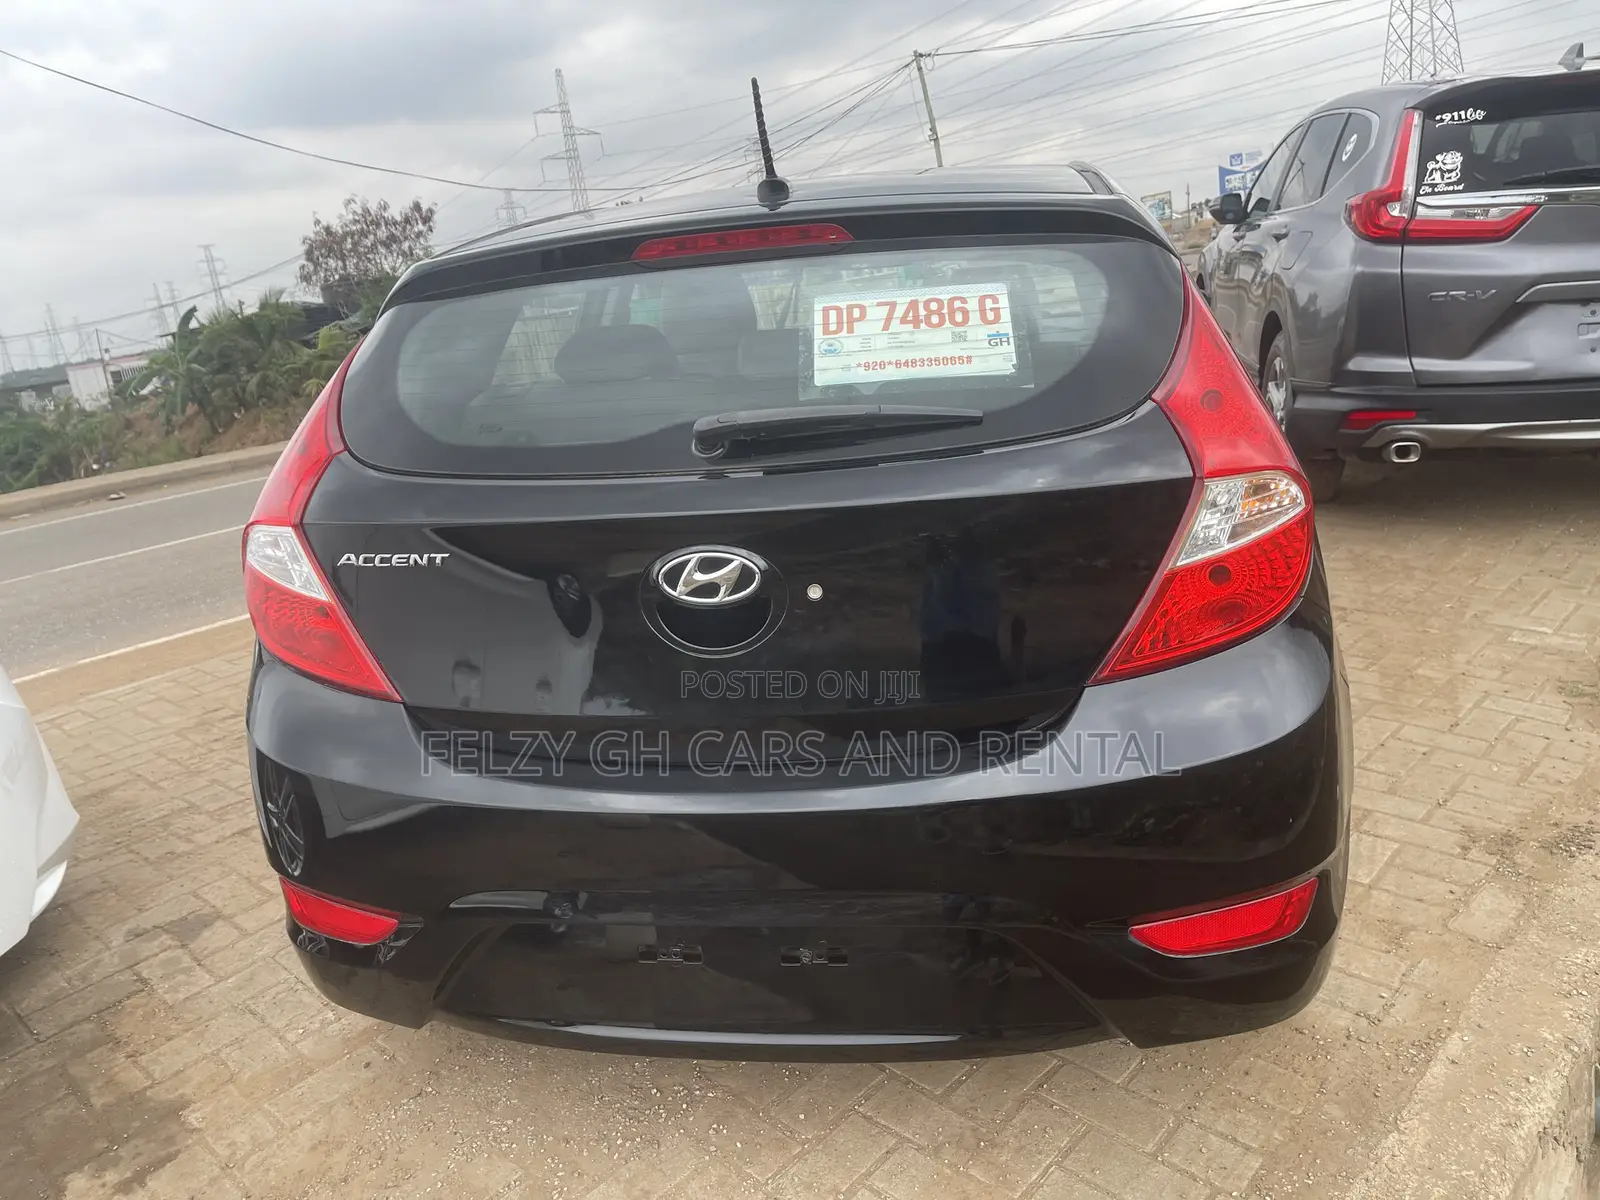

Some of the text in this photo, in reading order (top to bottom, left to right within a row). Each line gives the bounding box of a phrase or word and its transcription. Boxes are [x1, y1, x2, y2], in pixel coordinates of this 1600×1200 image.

[1428, 289, 1497, 301] CR-V
[821, 294, 1002, 336] DP 7486 G
[987, 336, 1011, 348] GH
[337, 553, 450, 567] ACCENT
